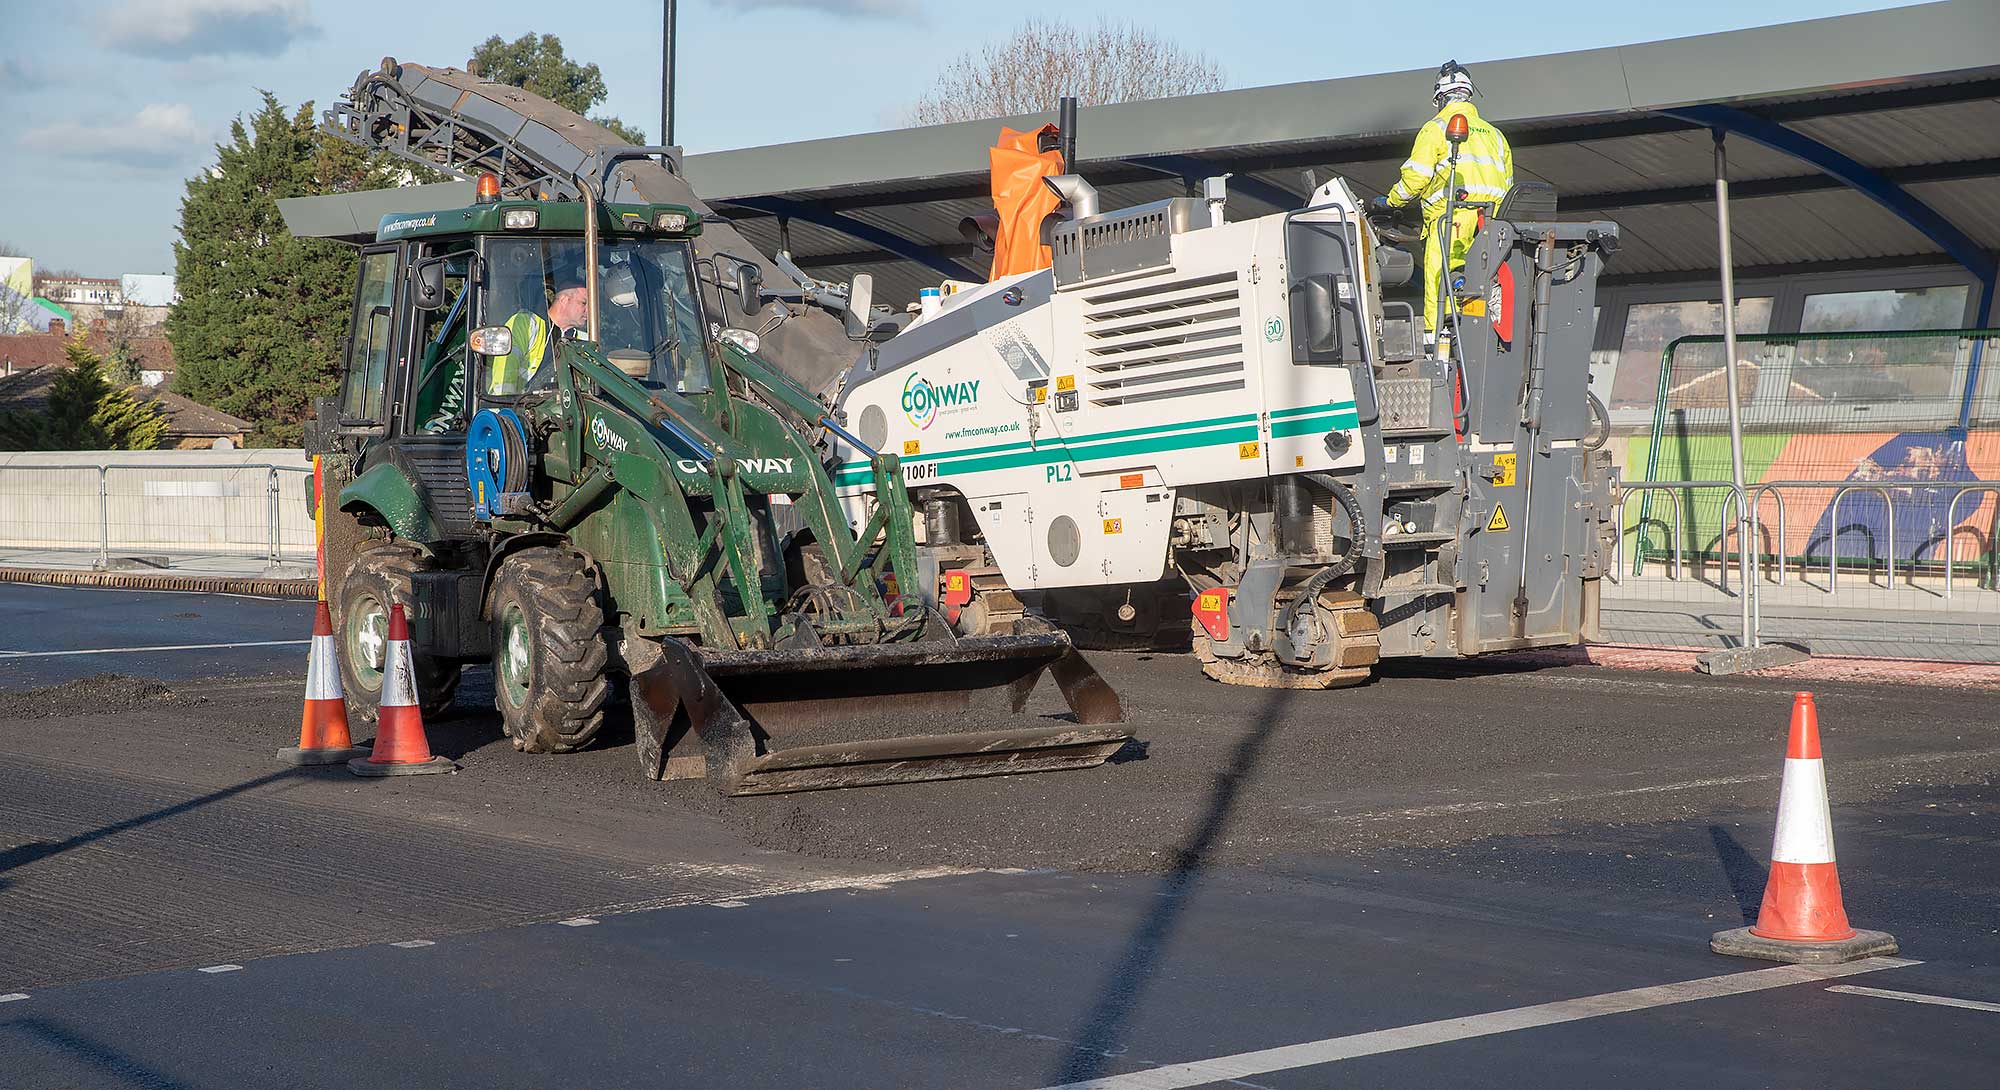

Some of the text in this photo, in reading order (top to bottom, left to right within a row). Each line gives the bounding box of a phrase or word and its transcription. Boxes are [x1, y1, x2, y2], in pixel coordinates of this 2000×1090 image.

[1268, 320, 1281, 335] 50
[901, 379, 980, 412] CONWAY
[591, 416, 628, 452] CONWAY
[928, 463, 936, 478] Fi
[1046, 463, 1072, 483] PL2
